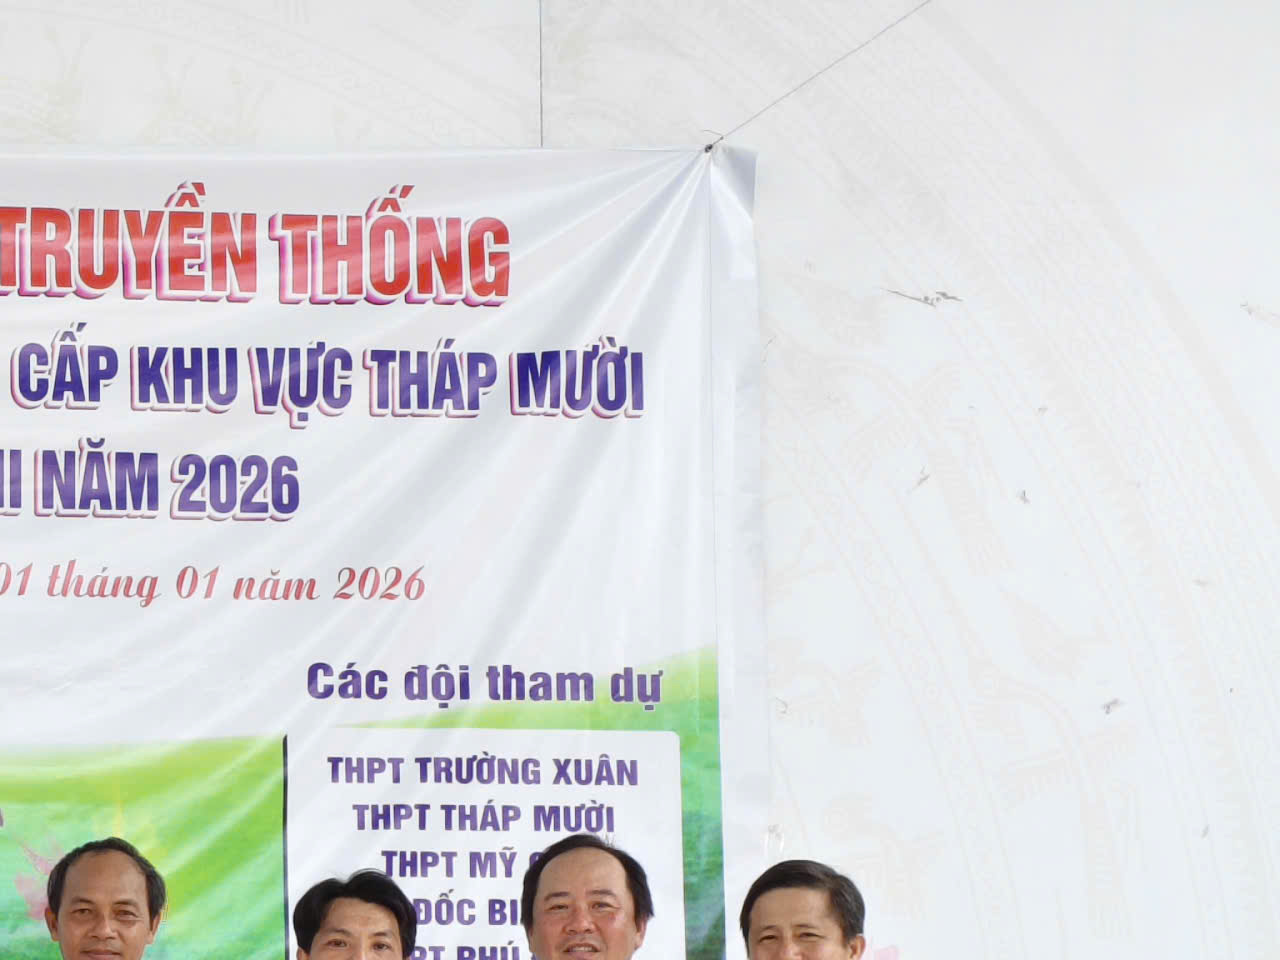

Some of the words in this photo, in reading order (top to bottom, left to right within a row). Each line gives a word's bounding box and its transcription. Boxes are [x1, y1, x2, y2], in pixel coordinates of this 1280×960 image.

[269, 184, 511, 308] THỐNG
[10, 322, 119, 411] CẤP
[130, 345, 238, 413] KHU
[248, 340, 353, 430] VỰC
[363, 338, 499, 419] THÁP
[510, 335, 645, 419] MƯỜI
[34, 437, 159, 521] NĂM
[170, 454, 300, 522] 2026
[46, 559, 162, 608] tháng
[175, 564, 220, 600] 01
[232, 568, 321, 601] năm
[332, 565, 426, 601] 2026
[306, 661, 388, 700] Các
[404, 662, 470, 709] đội
[486, 664, 594, 703] tham
[610, 666, 663, 711] dự
[326, 756, 405, 784] THPT
[415, 751, 541, 786] TRƯỜNG
[552, 753, 639, 786] XUÂN
[352, 803, 431, 831] THPT
[440, 799, 521, 832] THÁP
[532, 799, 615, 833] MƯỜI
[381, 850, 458, 878] THPT
[469, 846, 518, 878] MỸ
[412, 889, 476, 926] ĐỐC
